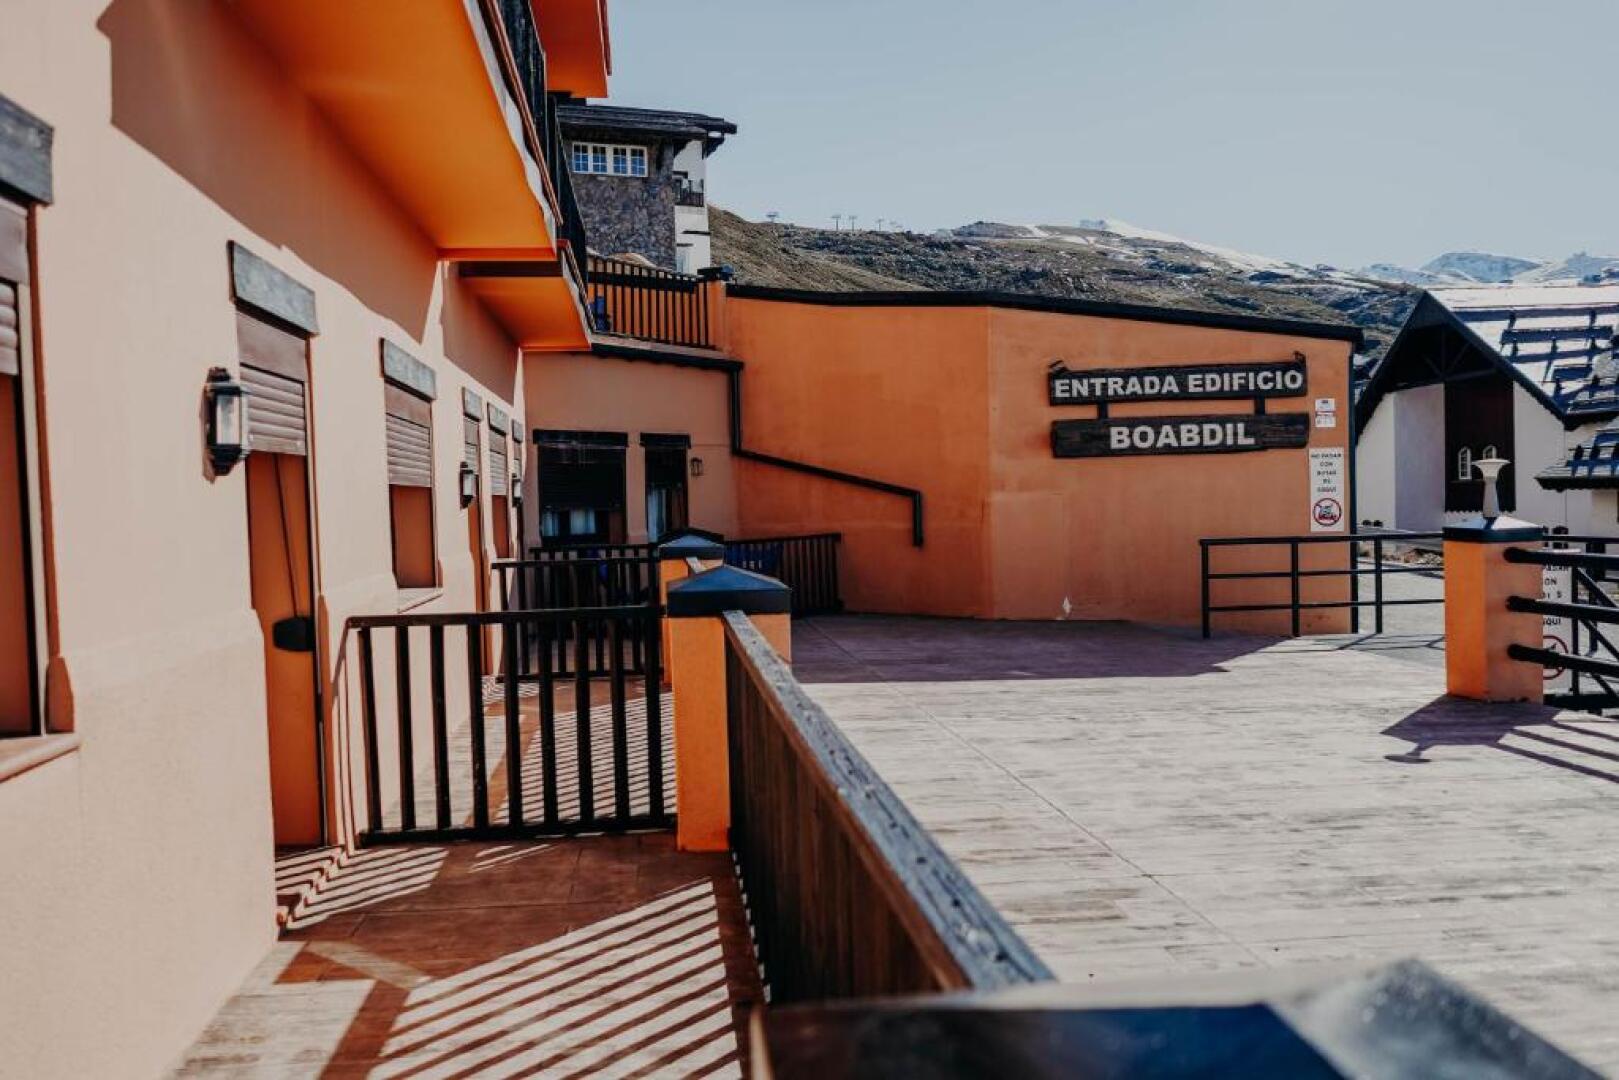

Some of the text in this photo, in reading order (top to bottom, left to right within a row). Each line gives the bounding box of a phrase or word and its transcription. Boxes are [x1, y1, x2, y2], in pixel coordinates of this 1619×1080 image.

[1054, 370, 1304, 398] ENTRADA EDIFICIO
[1109, 422, 1256, 449] BOABDIL
